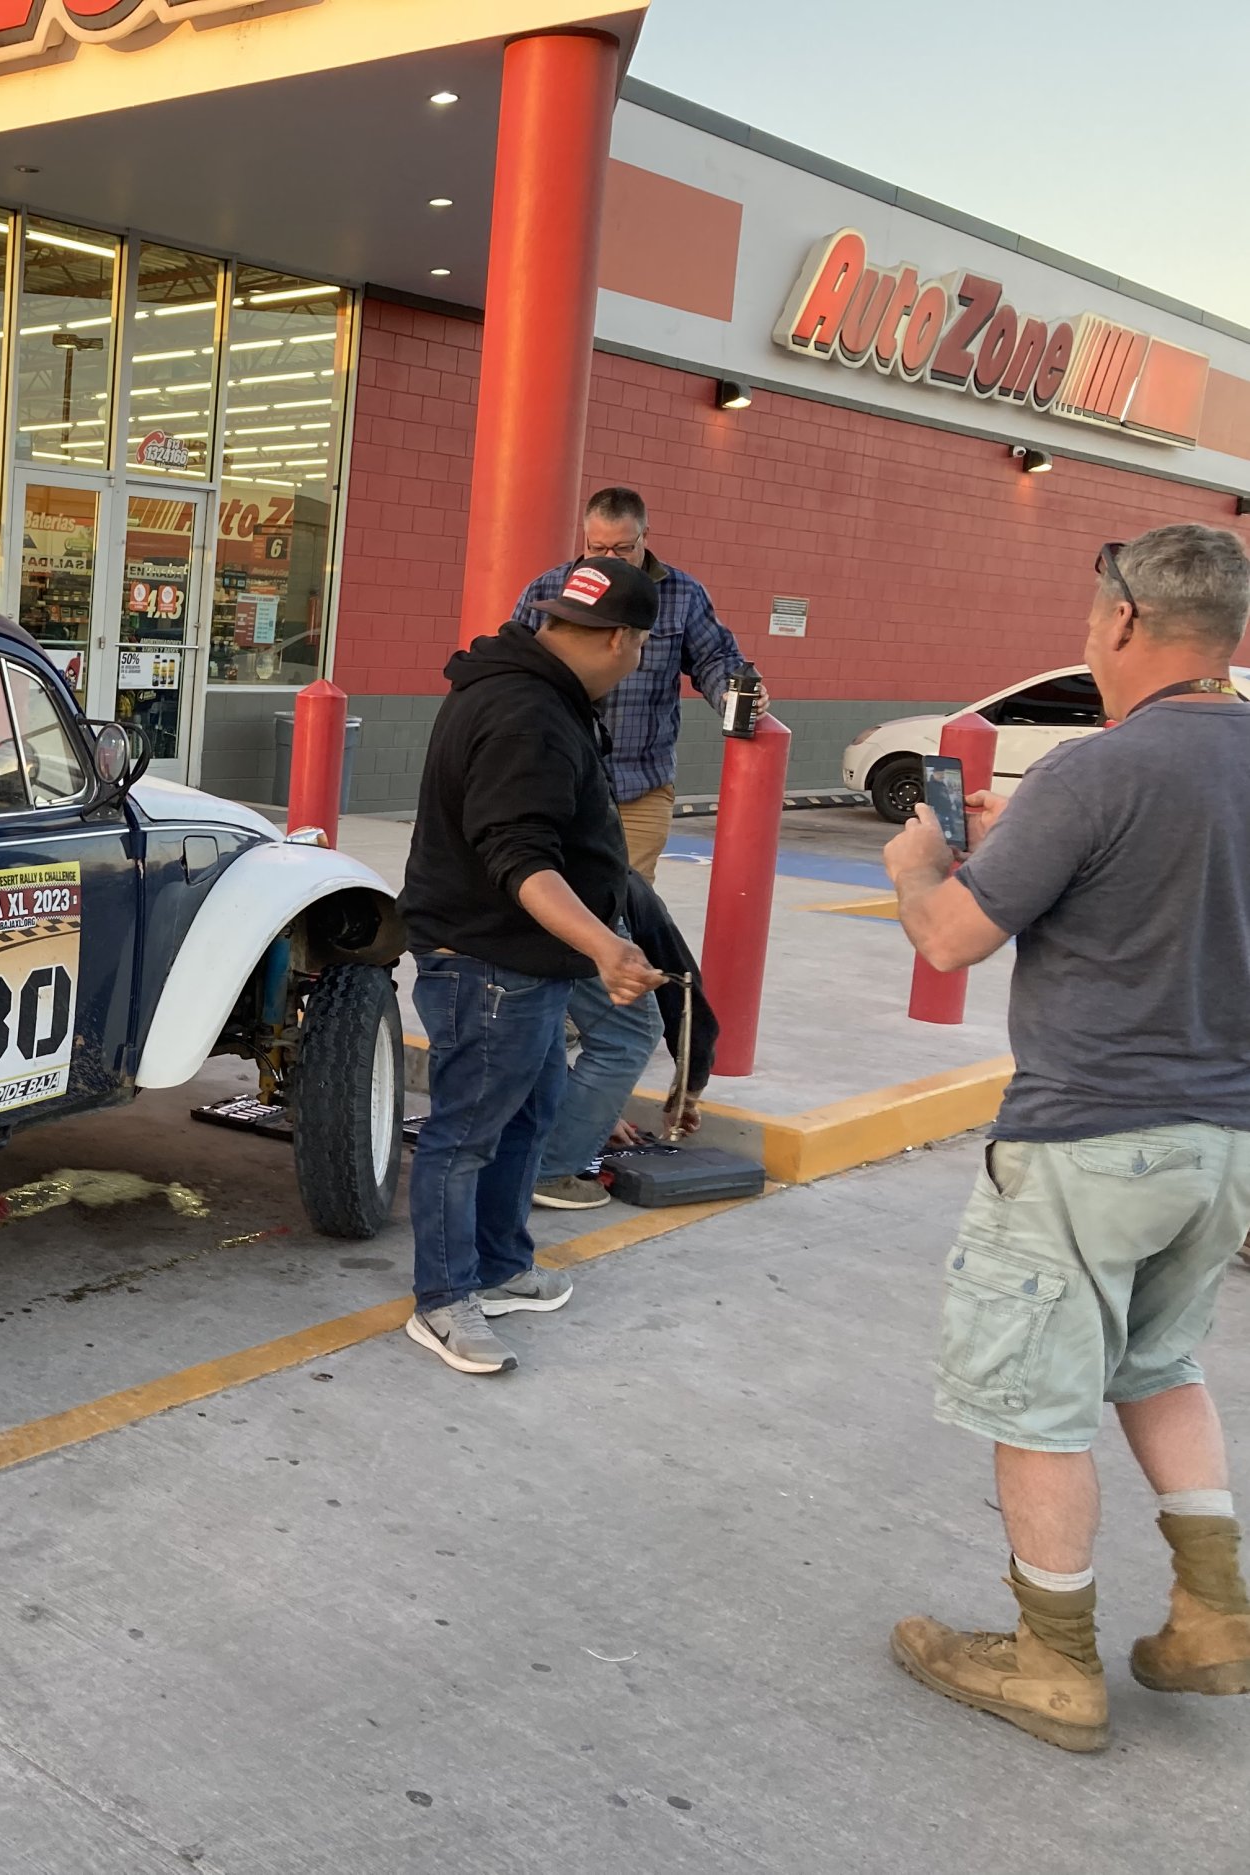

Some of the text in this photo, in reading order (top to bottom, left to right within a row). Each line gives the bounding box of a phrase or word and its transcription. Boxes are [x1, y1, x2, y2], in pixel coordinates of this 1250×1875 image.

[792, 226, 1074, 404] AutoZone
[146, 446, 188, 464] 1324166
[271, 539, 283, 558] 6
[121, 653, 140, 665] 50%
[19, 872, 38, 884] RALLY
[38, 872, 44, 882] &
[44, 871, 76, 882] CHALLENGE
[8, 892, 29, 917] XL
[33, 888, 70, 914] 2023
[0, 917, 36, 930] BAJAXL.ORG
[27, 1071, 61, 1094] BAJA
